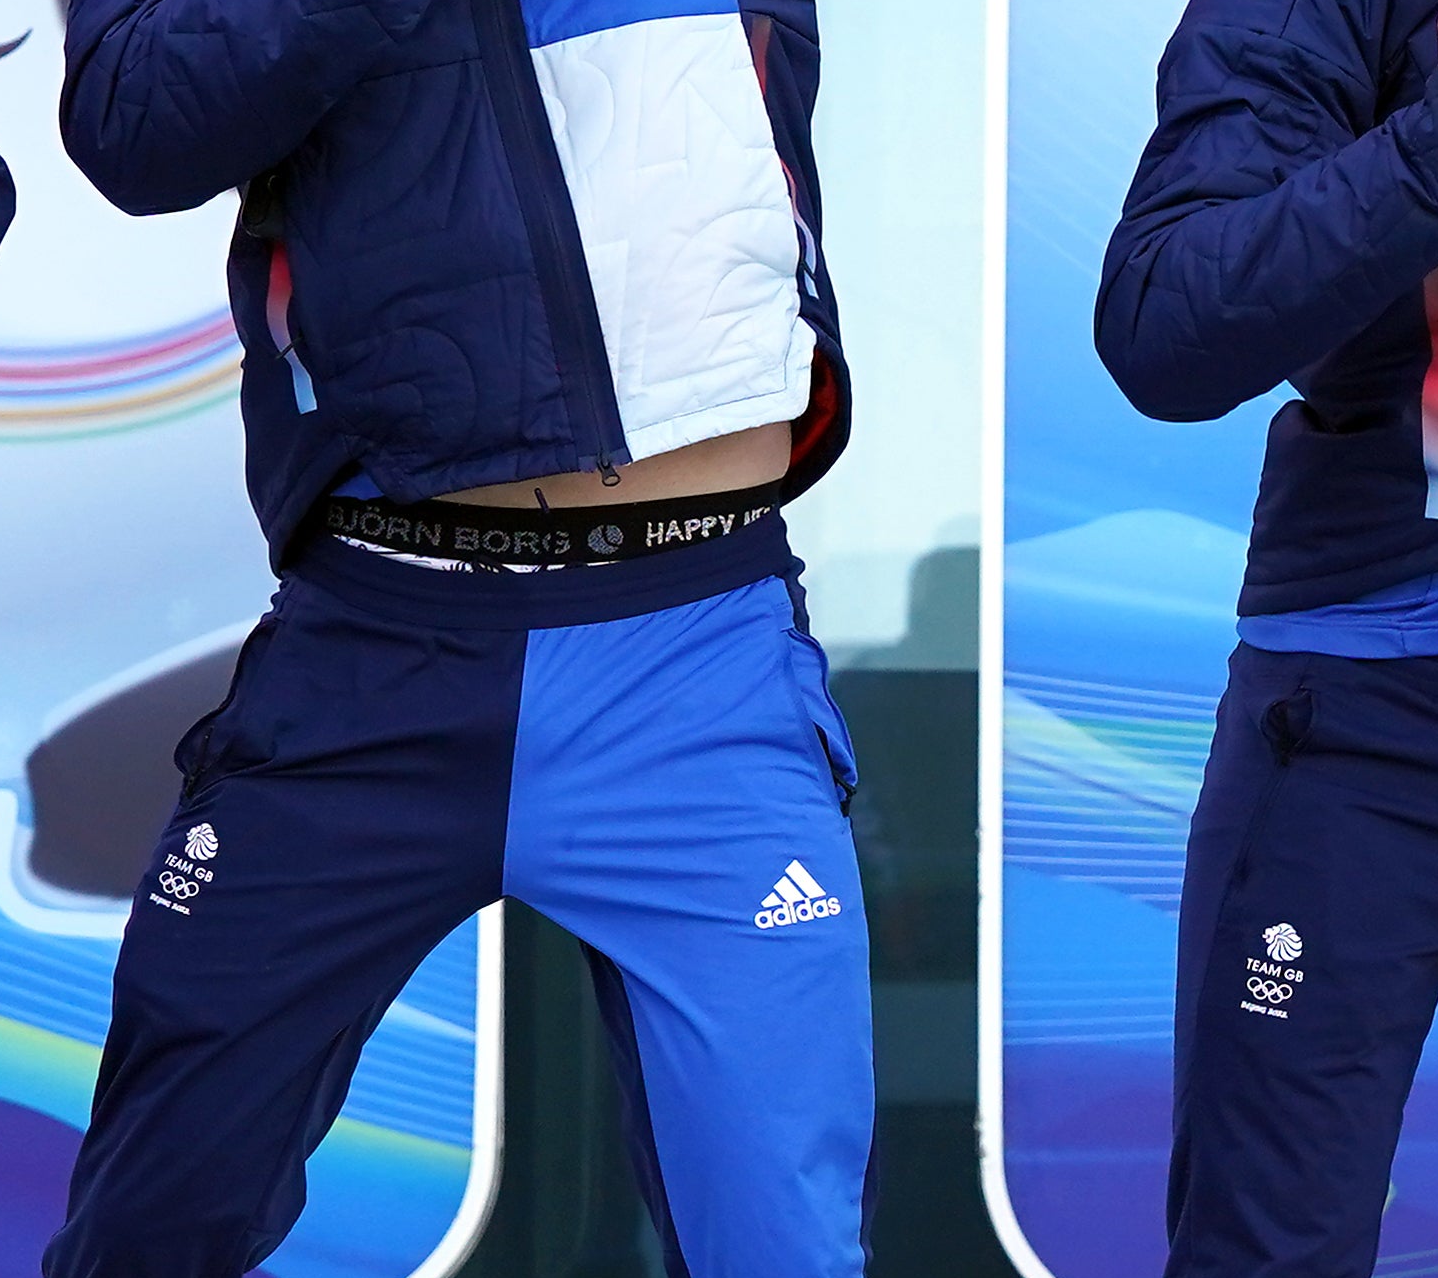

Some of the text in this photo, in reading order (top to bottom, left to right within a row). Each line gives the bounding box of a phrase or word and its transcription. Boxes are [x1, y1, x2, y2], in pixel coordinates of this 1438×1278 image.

[454, 525, 571, 555] BORG
[645, 513, 736, 548] HAPPY
[164, 853, 214, 883] TEAM GB
[753, 896, 842, 930] adidas
[1246, 957, 1304, 983] TEAM GB
